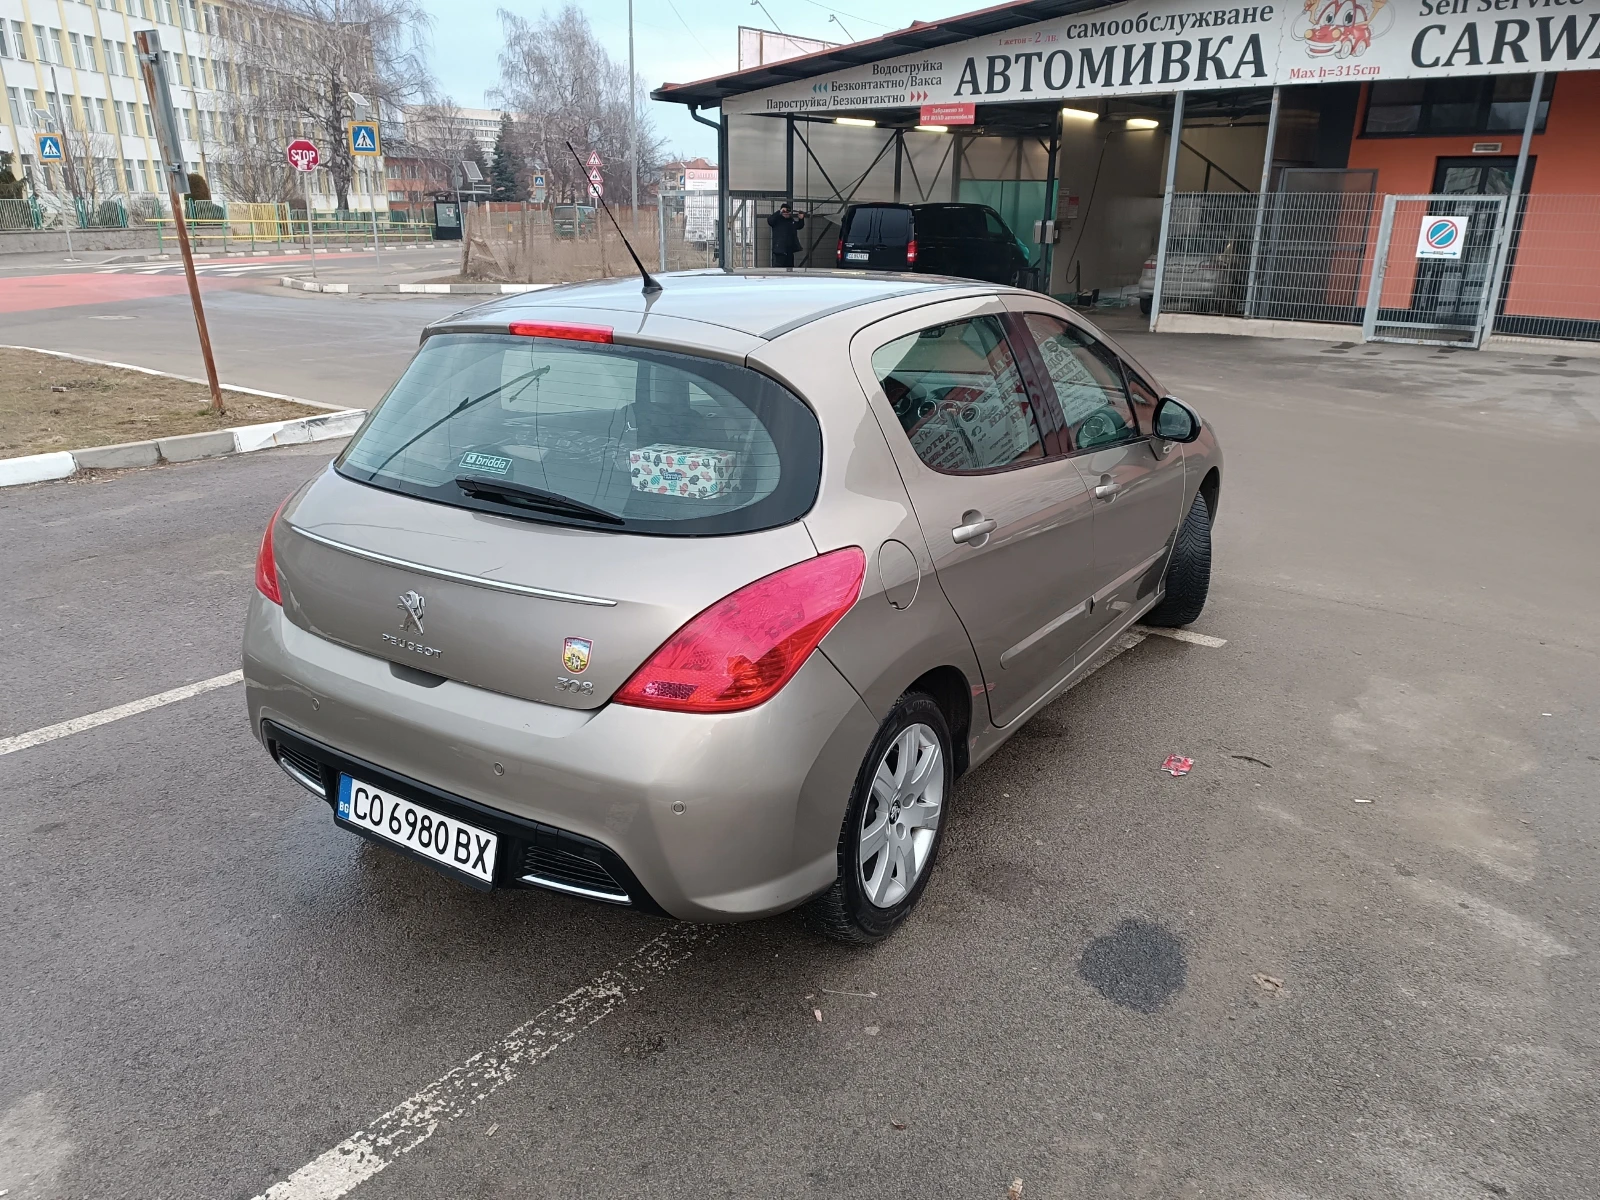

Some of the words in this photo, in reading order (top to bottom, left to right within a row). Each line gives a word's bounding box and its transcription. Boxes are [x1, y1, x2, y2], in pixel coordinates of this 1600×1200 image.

[1067, 5, 1274, 39] самообслужване
[1004, 37, 1026, 45] жетон
[1035, 31, 1042, 43] 2
[1045, 34, 1059, 42] лв.
[1411, 12, 1600, 68] CARW
[872, 61, 943, 76] Водоструйка
[953, 33, 1268, 96] АВТОМИВКА
[1290, 68, 1316, 79] Max
[1318, 64, 1381, 78] h=315cm
[831, 76, 942, 92] Безконтактно/Вакса
[766, 94, 906, 111] Пароструйка/Безконтактно
[291, 149, 315, 161] STOP
[475, 456, 506, 468] bridda
[382, 633, 443, 659] PEUGEOT
[554, 676, 594, 696] 308
[339, 801, 349, 813] BG
